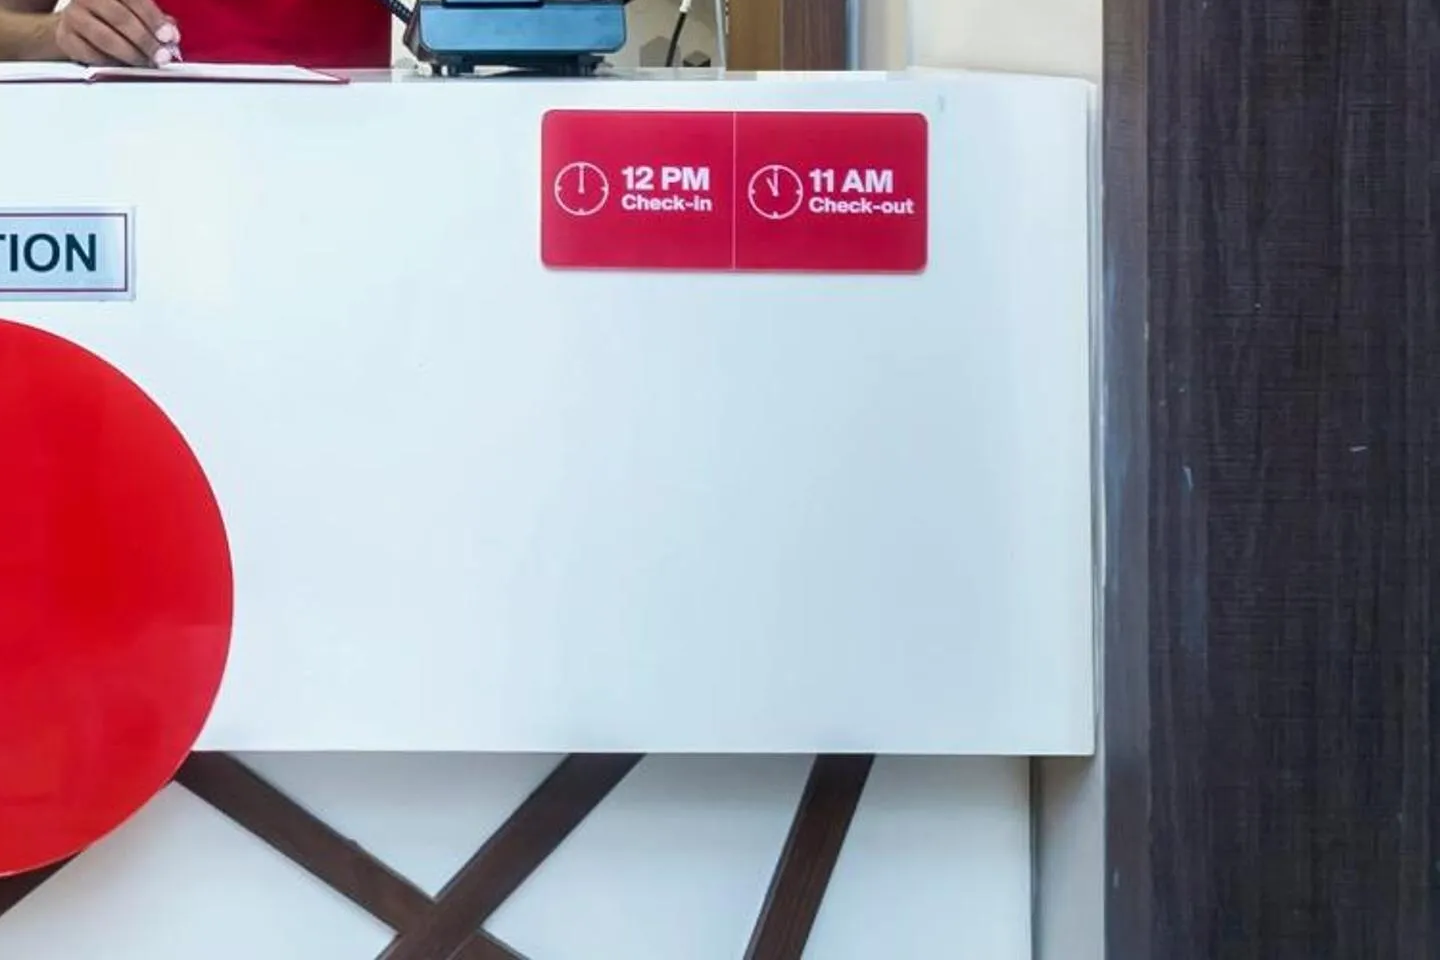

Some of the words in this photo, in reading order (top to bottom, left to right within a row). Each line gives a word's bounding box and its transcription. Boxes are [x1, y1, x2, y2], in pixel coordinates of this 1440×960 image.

[621, 166, 654, 191] 12
[661, 166, 710, 191] PM
[809, 168, 834, 193] 11
[843, 168, 893, 193] AM
[621, 193, 712, 212] Check-in
[808, 196, 914, 214] Check-out
